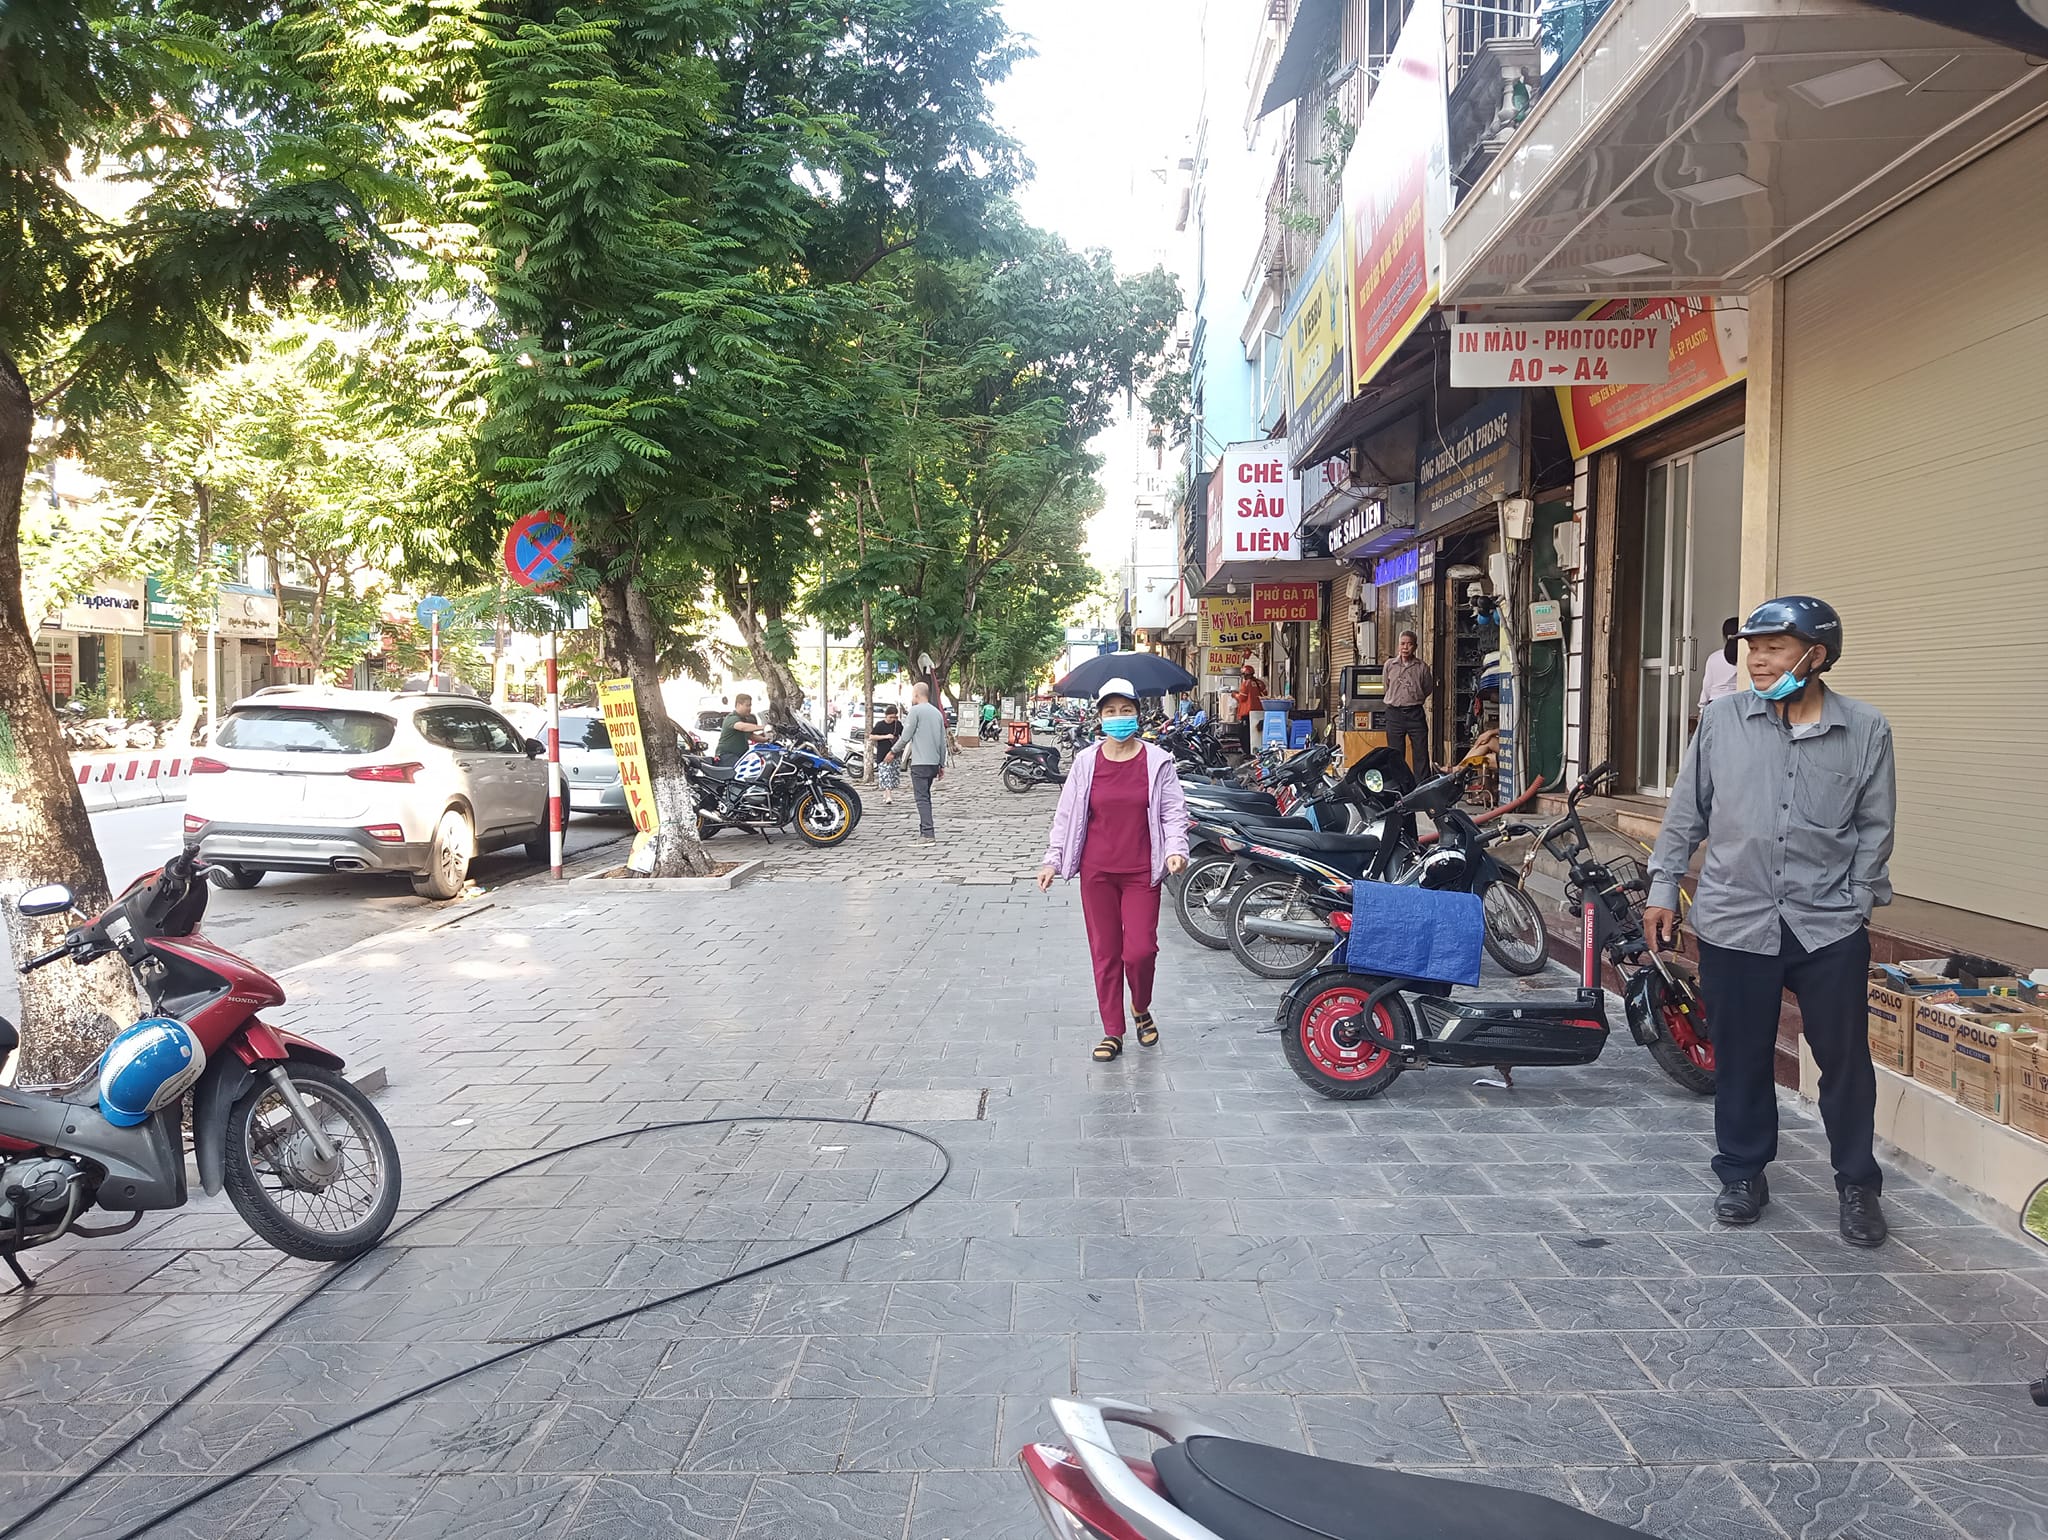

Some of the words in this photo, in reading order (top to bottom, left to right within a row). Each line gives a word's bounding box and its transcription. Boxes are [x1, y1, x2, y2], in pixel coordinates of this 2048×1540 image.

[1458, 332, 1478, 353] IN
[1484, 328, 1527, 352] MÀU
[1544, 328, 1658, 352] PHOTOCOPY
[1573, 357, 1609, 381] A4
[1476, 412, 1508, 452] PHONG
[1238, 459, 1283, 484] CHÈ
[1237, 489, 1284, 518] SẦU
[1236, 528, 1290, 552] LIÊN
[1255, 586, 1280, 601] PHỞ
[1283, 587, 1297, 600] GÀ
[1302, 588, 1315, 599] TA
[1263, 605, 1287, 619] PHỐ
[1209, 652, 1223, 664] BIA
[603, 703, 613, 719] IN
[614, 699, 635, 718] MÀU
[609, 721, 637, 738] PHOTO
[614, 741, 638, 758] SCAN
[620, 760, 641, 786] A4
[228, 996, 258, 1005] HONDA
[1868, 988, 1902, 1009] APOLLO
[1915, 1005, 1956, 1028] APOLLO
[1956, 1024, 1997, 1048] APOLLO
